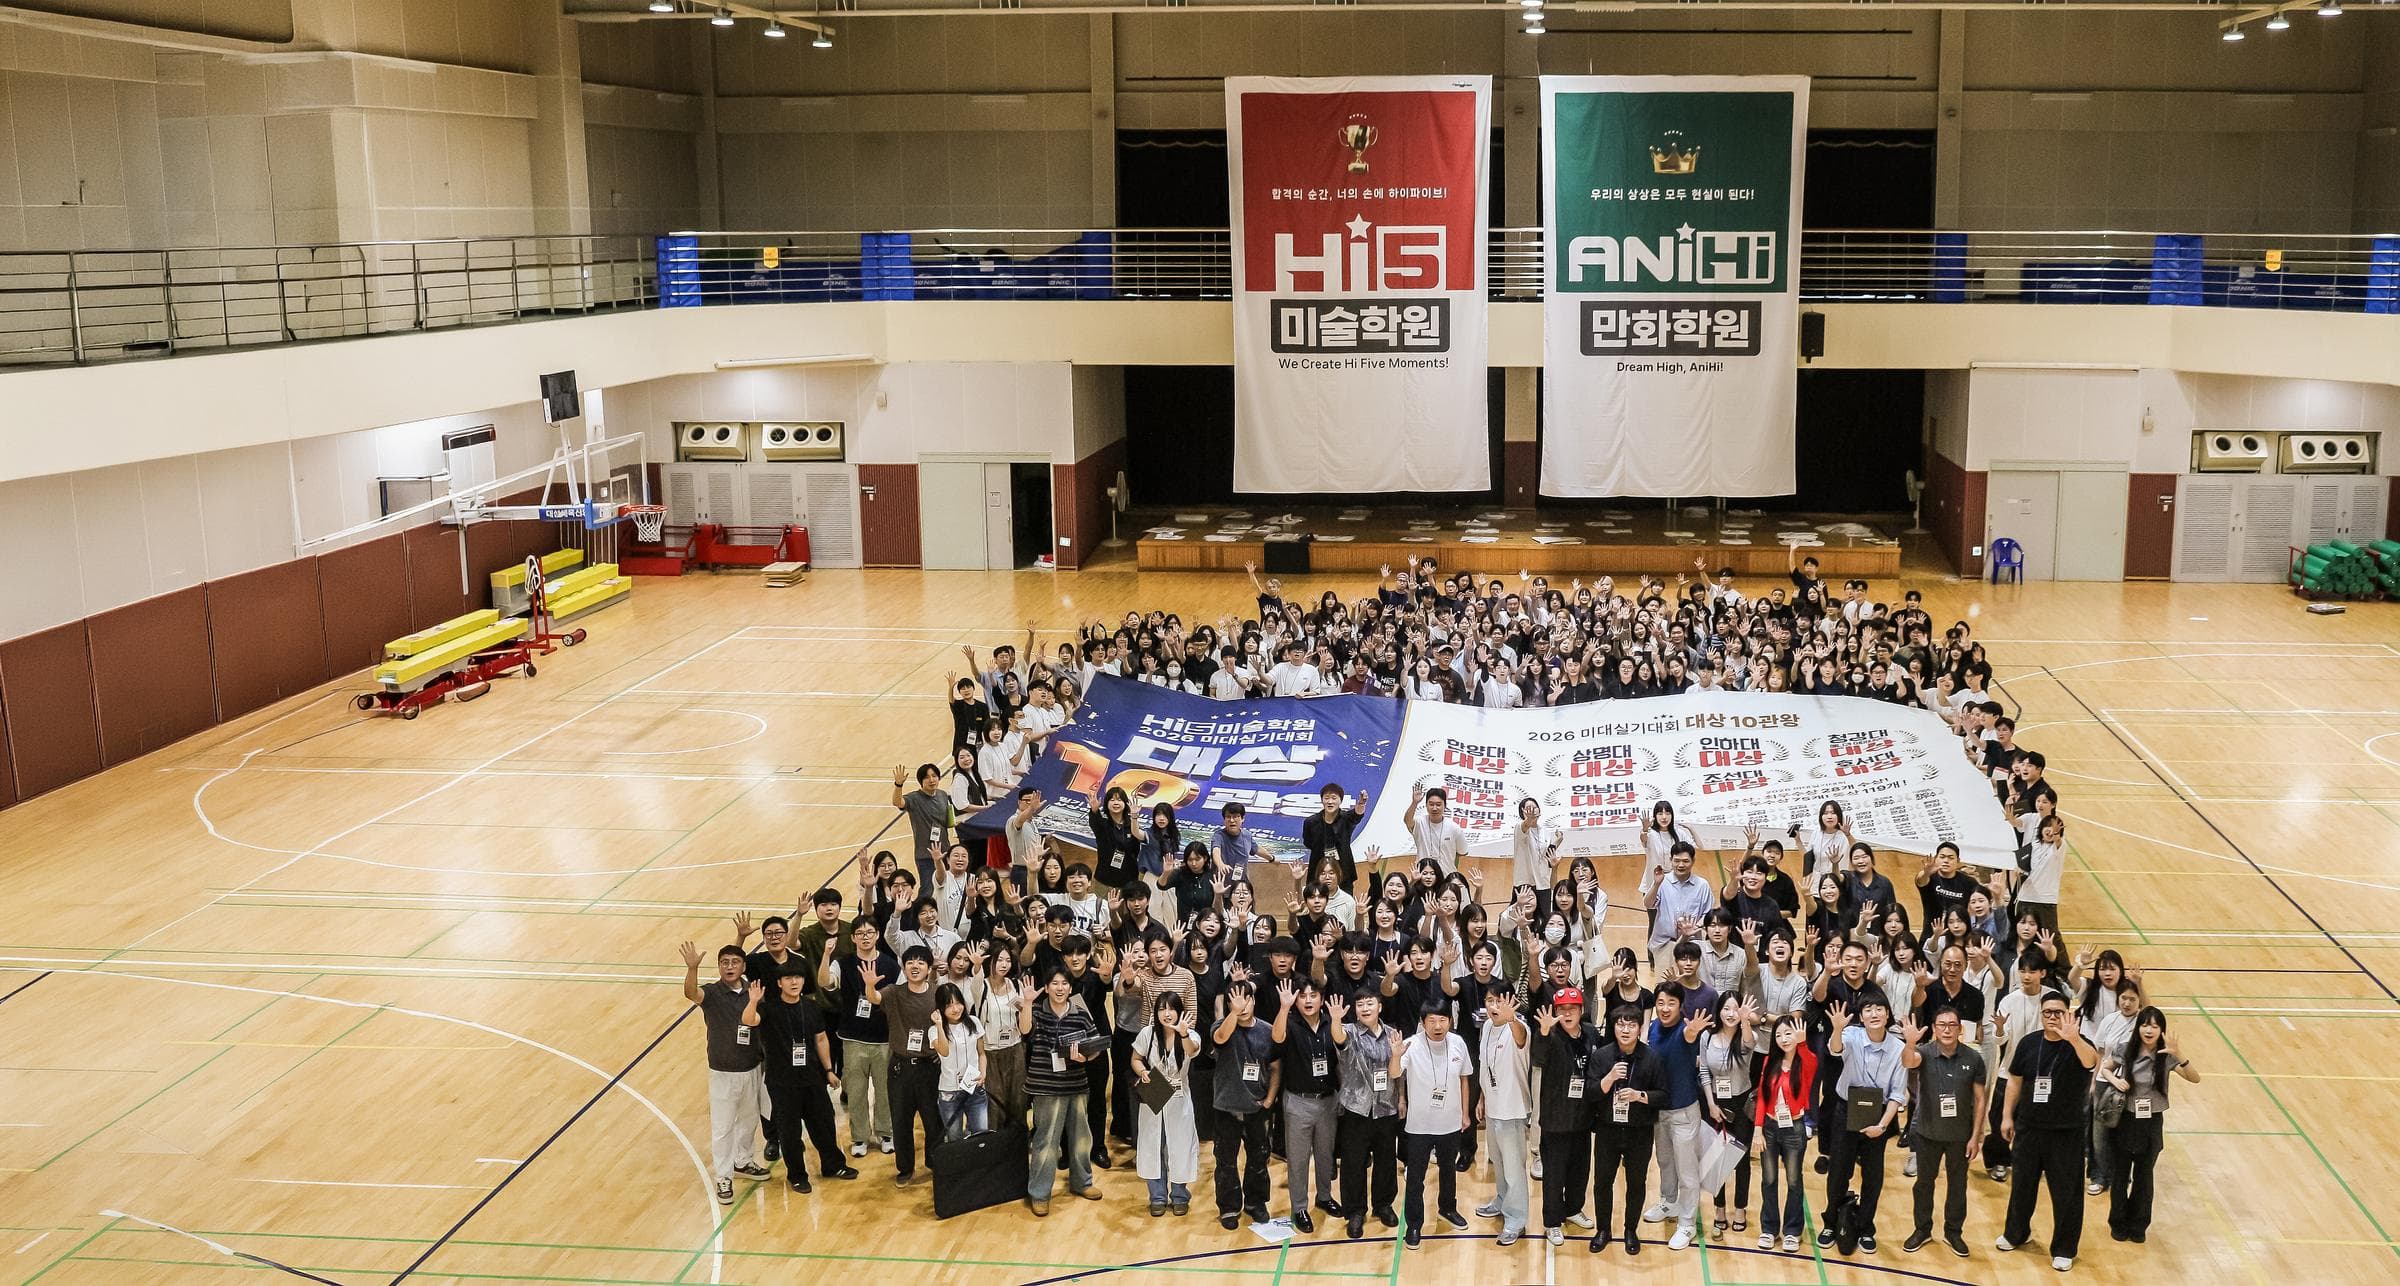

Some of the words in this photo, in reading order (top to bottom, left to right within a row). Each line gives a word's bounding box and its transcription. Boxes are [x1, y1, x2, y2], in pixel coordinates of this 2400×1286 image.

[1272, 188, 1303, 201] 합격의
[1307, 188, 1333, 201] 순간,
[1337, 188, 1358, 200] 너의
[1362, 188, 1384, 200] 손에
[1388, 187, 1448, 199] 하이파이브!
[1591, 188, 1624, 201] 우리의
[1628, 188, 1661, 201] 상상은
[1665, 188, 1688, 200] 모두
[1692, 188, 1724, 201] 현실이
[1728, 188, 1754, 201] 된다!
[1280, 305, 1441, 347] 미술학원
[1592, 308, 1750, 349] 만화학원
[1279, 357, 1298, 369] We
[1301, 357, 1342, 369] Create
[1345, 357, 1358, 370] Hi
[1361, 357, 1386, 370] Five
[1389, 357, 1449, 369] Moments!
[1617, 361, 1653, 374] Dream
[1656, 361, 1687, 375] High,
[1690, 361, 1724, 374] AniHi!
[1138, 725, 1195, 743] 2026
[1201, 731, 1313, 745] 미대실기대회
[1217, 719, 1315, 735] 미술학원
[1528, 730, 1575, 742] 2026
[1581, 719, 1680, 739] 미대실기대회
[1685, 714, 1727, 728] 대상
[1730, 713, 1800, 728] 10관왕
[1446, 738, 1506, 759] 한양대
[1700, 737, 1760, 750] 인하대
[1830, 739, 1896, 757] 대상
[1117, 736, 1324, 786] 대상
[1444, 749, 1509, 774] 대상
[1572, 744, 1632, 762] 상명대
[1699, 750, 1766, 767] 대상
[1054, 741, 1202, 810] 10
[1570, 758, 1637, 778] 대상
[1835, 757, 1902, 777] 대상
[1702, 776, 1770, 795] 대상
[1703, 769, 1764, 784] 조선대
[1441, 785, 1508, 808] 대상
[1571, 782, 1634, 795] 한남대
[1571, 792, 1639, 807] 대상
[1570, 806, 1640, 818] 백석예대
[1571, 813, 1639, 828] 대상
